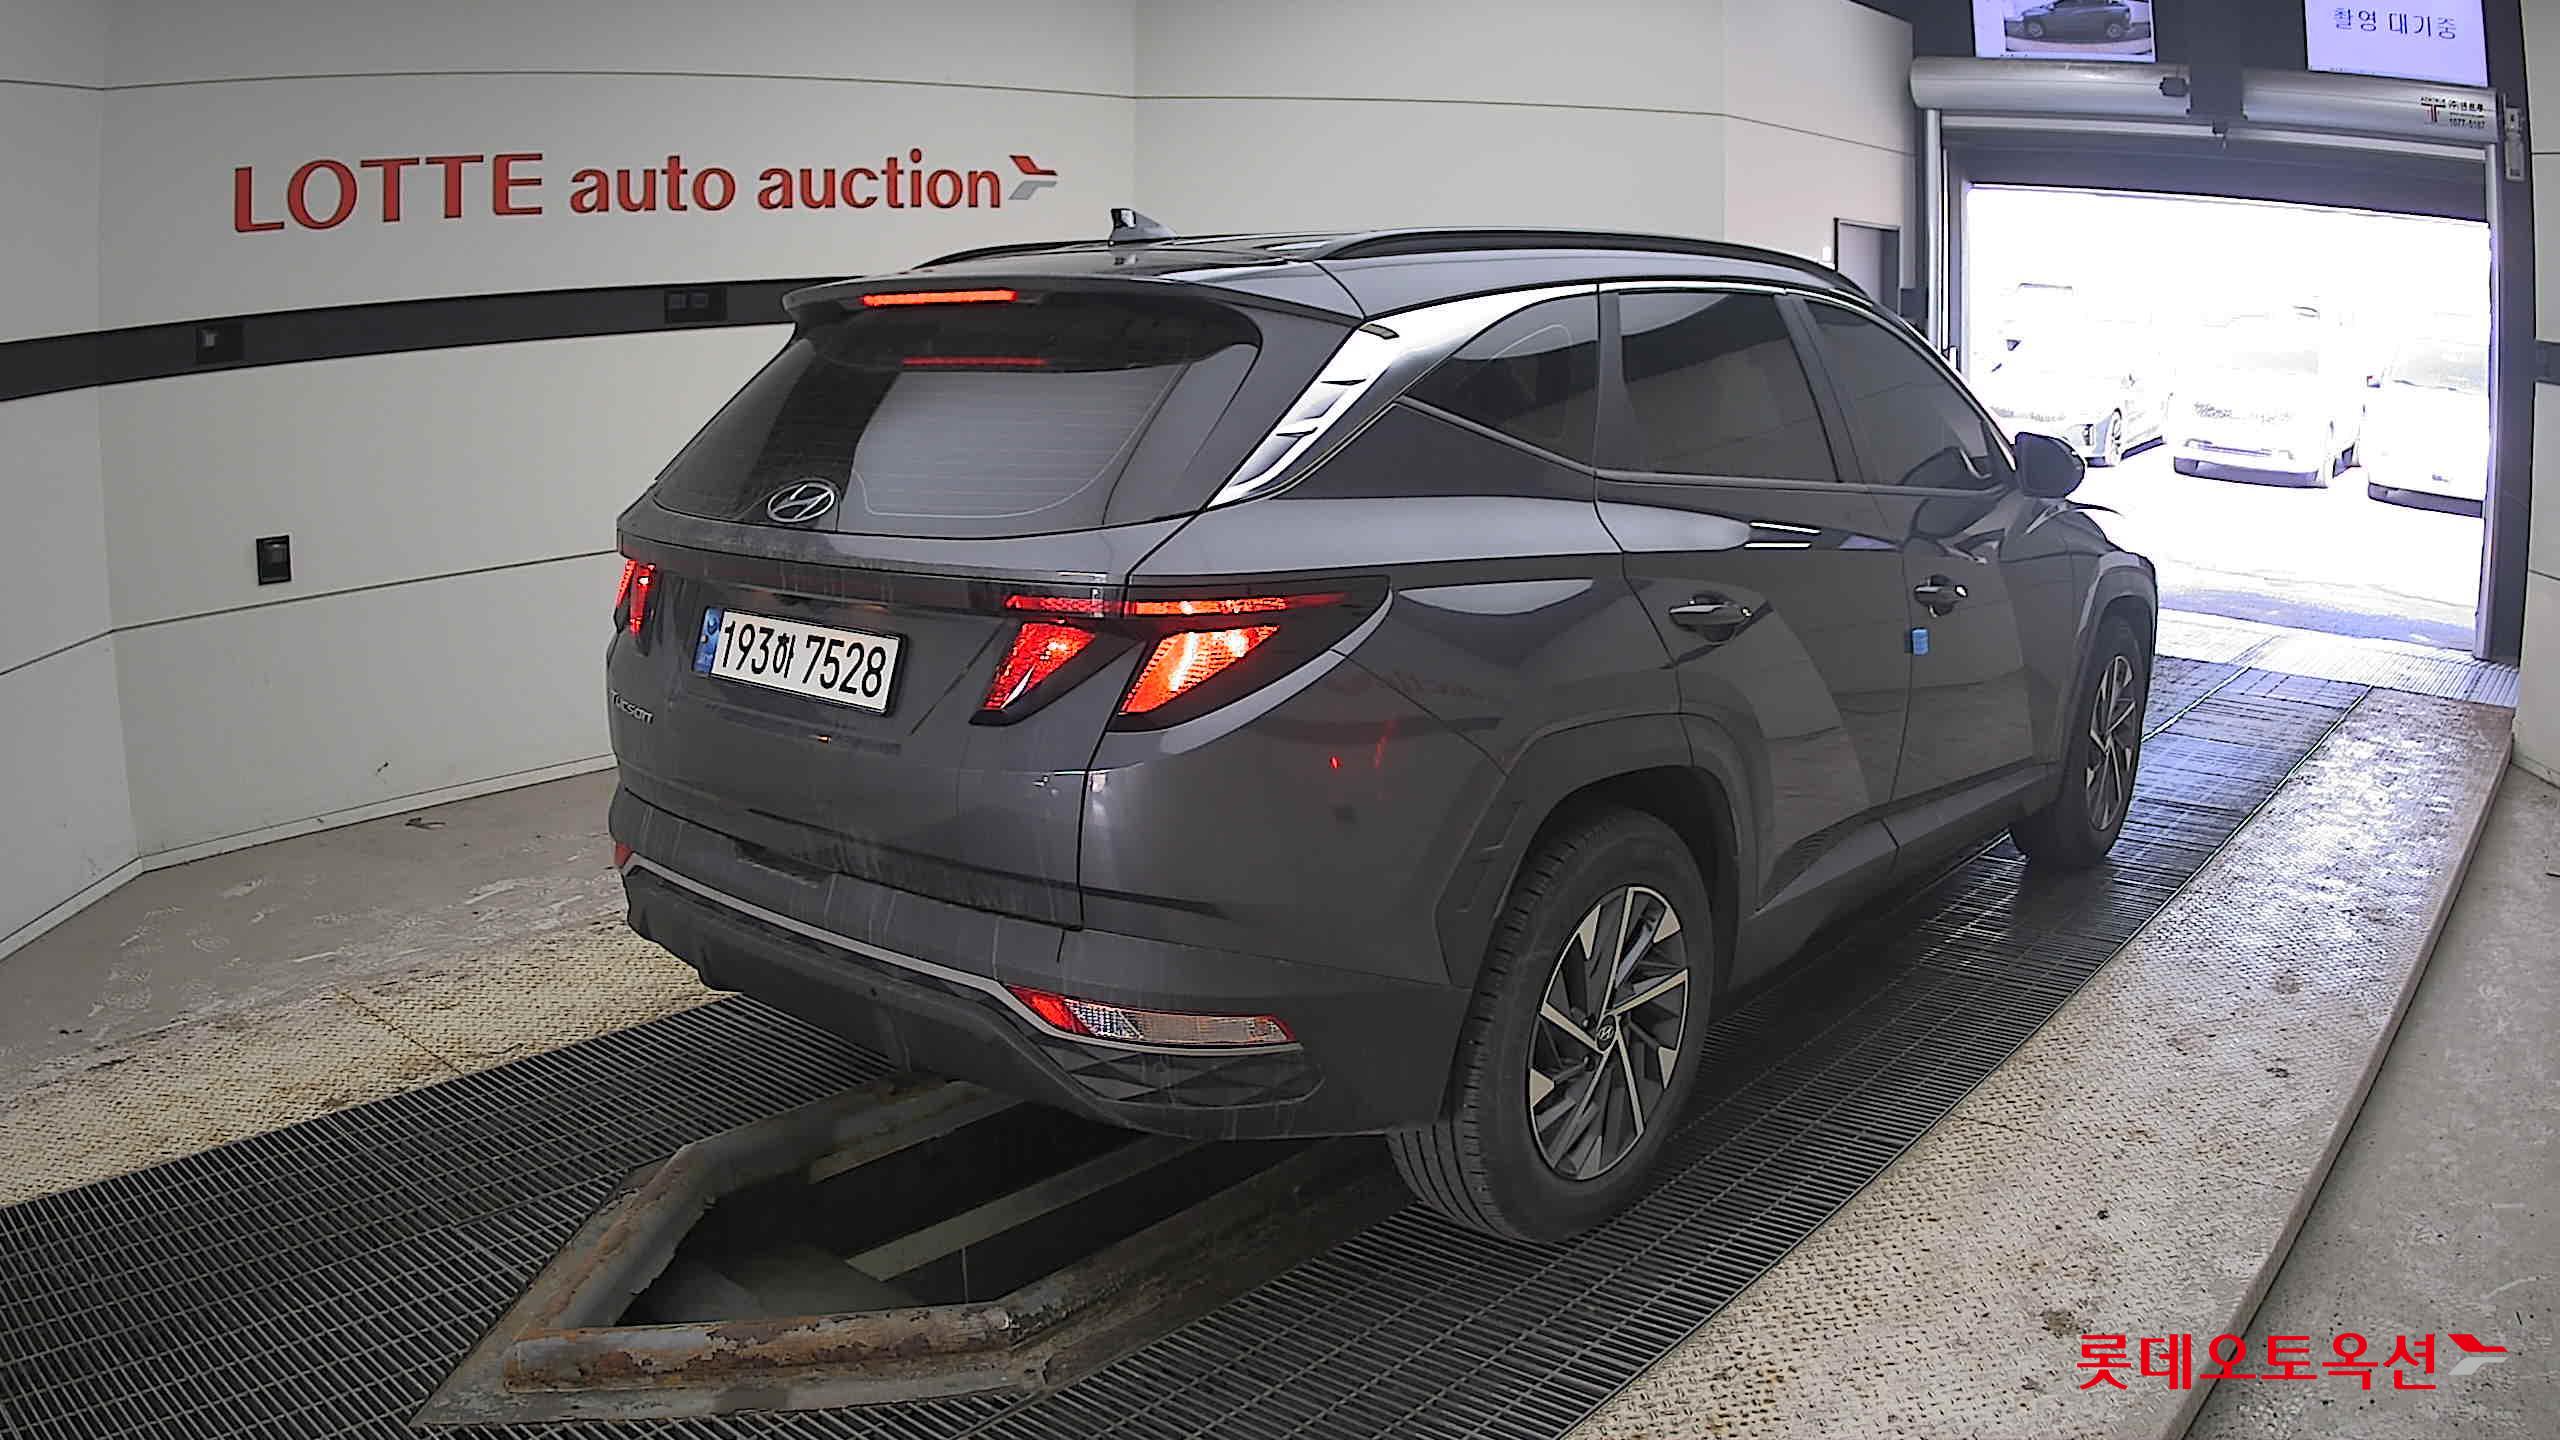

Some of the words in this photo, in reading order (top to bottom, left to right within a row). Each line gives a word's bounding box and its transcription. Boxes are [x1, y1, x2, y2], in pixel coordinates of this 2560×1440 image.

[2388, 11, 2456, 40] 대기중
[234, 152, 543, 233] LOTTE
[569, 153, 736, 214] auto
[756, 147, 1002, 211] auction
[722, 619, 796, 679] 193하
[802, 634, 887, 699] 7528
